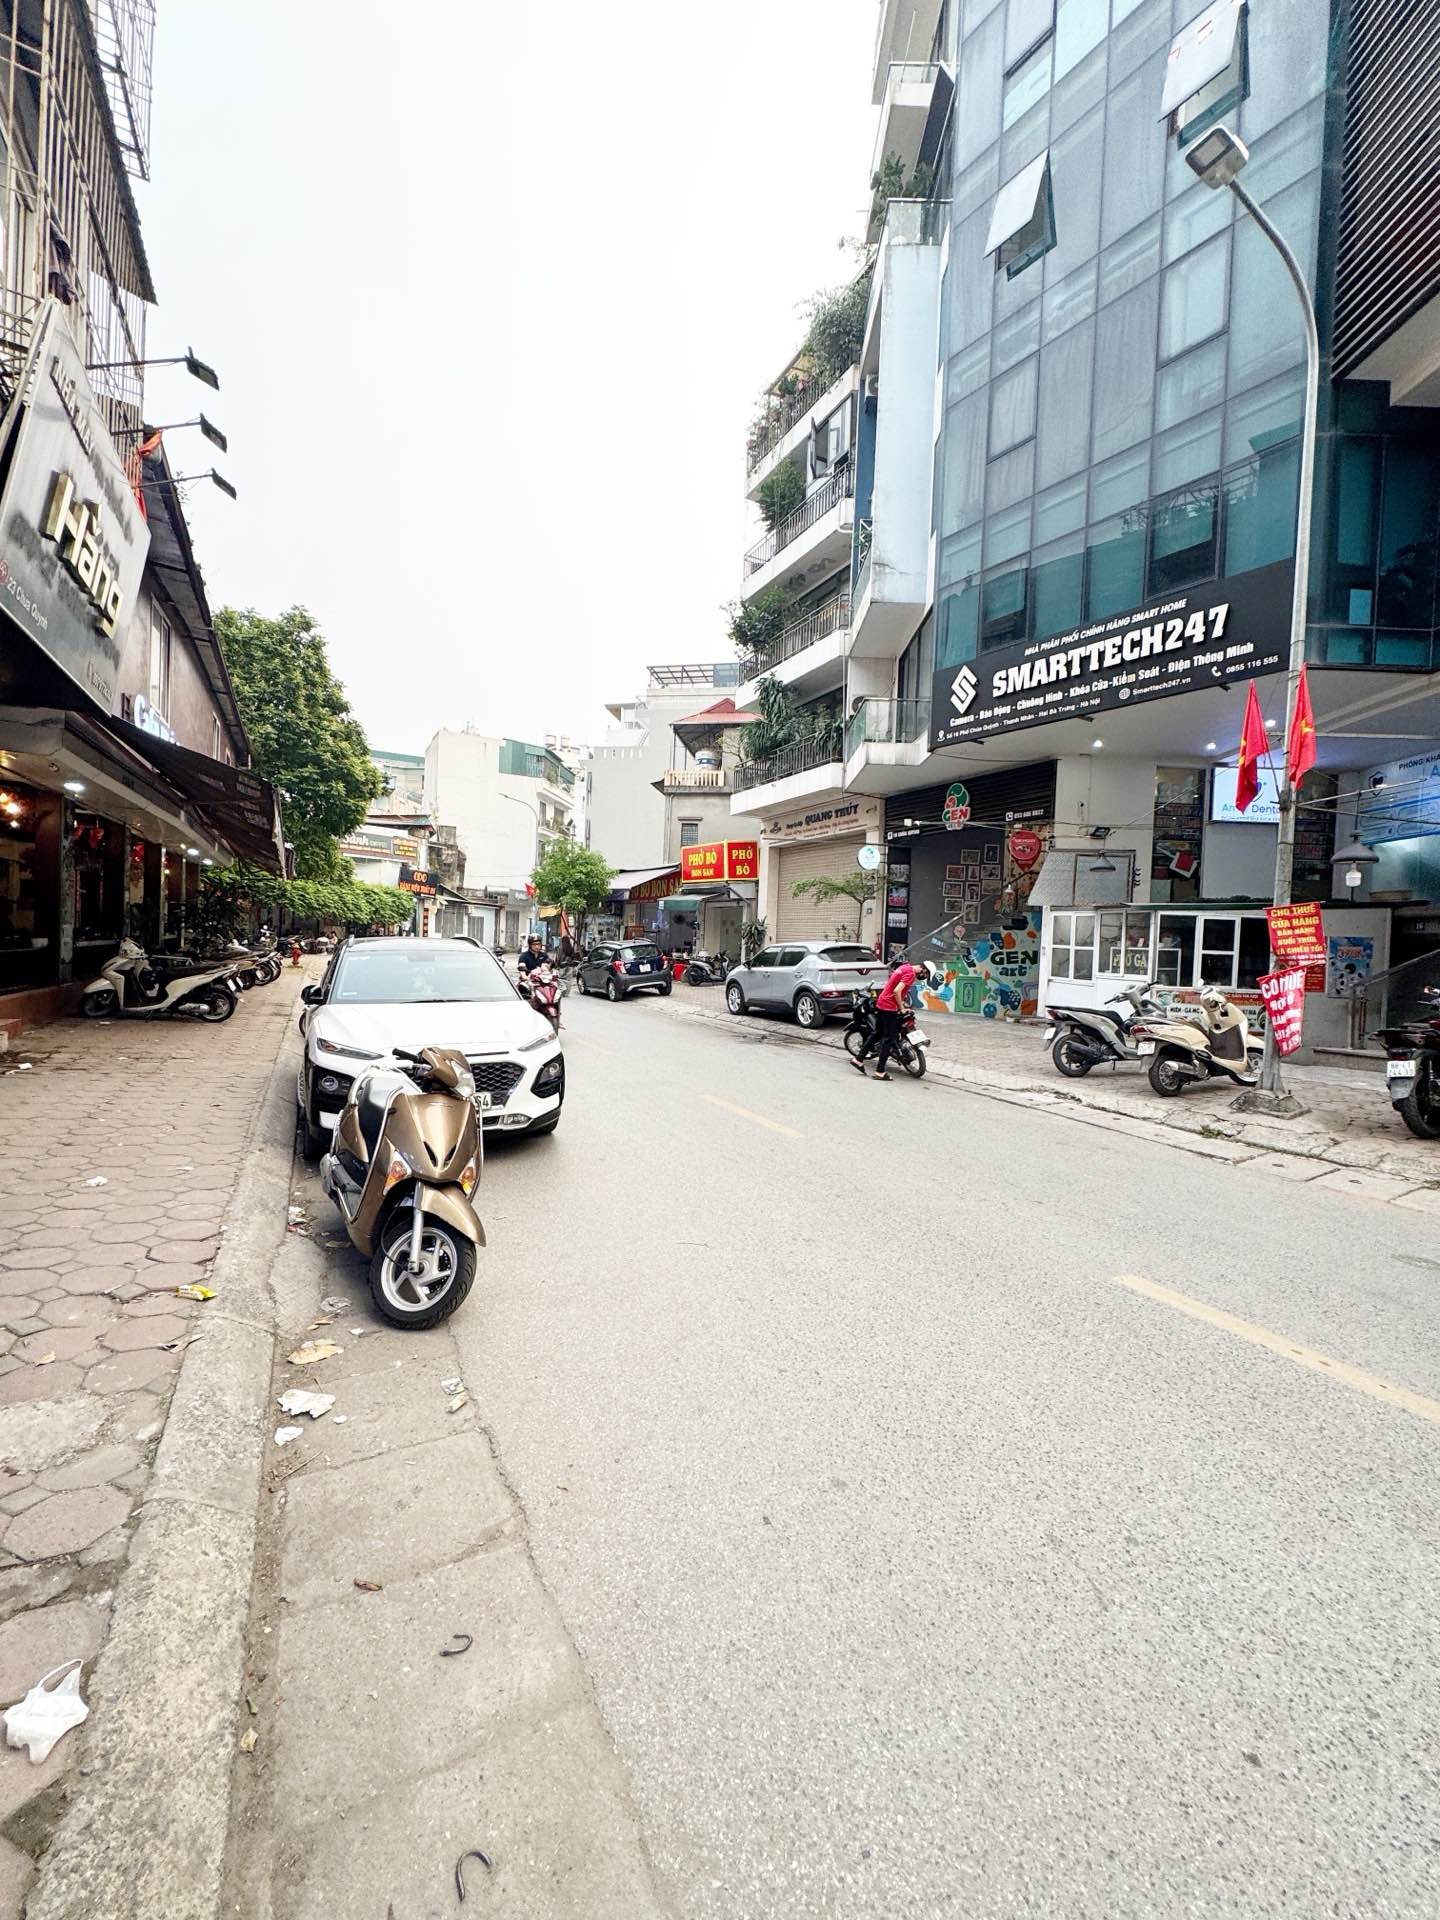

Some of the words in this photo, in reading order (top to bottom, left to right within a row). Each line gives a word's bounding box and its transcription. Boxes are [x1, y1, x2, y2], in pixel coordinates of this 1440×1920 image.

[1024, 643, 1039, 656] NHÀ
[1040, 638, 1059, 651] PHÂN
[1060, 630, 1079, 646] PHỐI
[1080, 623, 1105, 640] CHÍNH
[1131, 606, 1160, 624] SMART
[1160, 598, 1187, 615] HOME
[992, 603, 1229, 698] SMARTTECH247
[1263, 655, 1279, 666] 555
[950, 713, 974, 727] Camera
[994, 704, 1011, 717] Động
[1017, 695, 1044, 711] Chuông
[1045, 690, 1063, 705] Hình
[1070, 682, 1091, 698] Khóa
[1138, 665, 1160, 681] Soát
[1168, 657, 1191, 674] Điện
[1192, 650, 1224, 667] Thông
[1226, 641, 1254, 659] Minh
[1132, 676, 1191, 695] Smarttech247.vn
[942, 806, 970, 823] GEN
[688, 848, 704, 866] PHỞ
[705, 848, 717, 865] BÒ
[732, 846, 753, 860] PHỞ
[735, 863, 750, 875] BÒ
[1271, 908, 1290, 918] CHO
[1292, 903, 1316, 914] THUÊ
[1271, 918, 1290, 929] CỬA
[1291, 915, 1319, 926] HÀNG
[990, 951, 1038, 966] GEN
[1113, 950, 1133, 967] PỞ
[999, 965, 1027, 977] art
